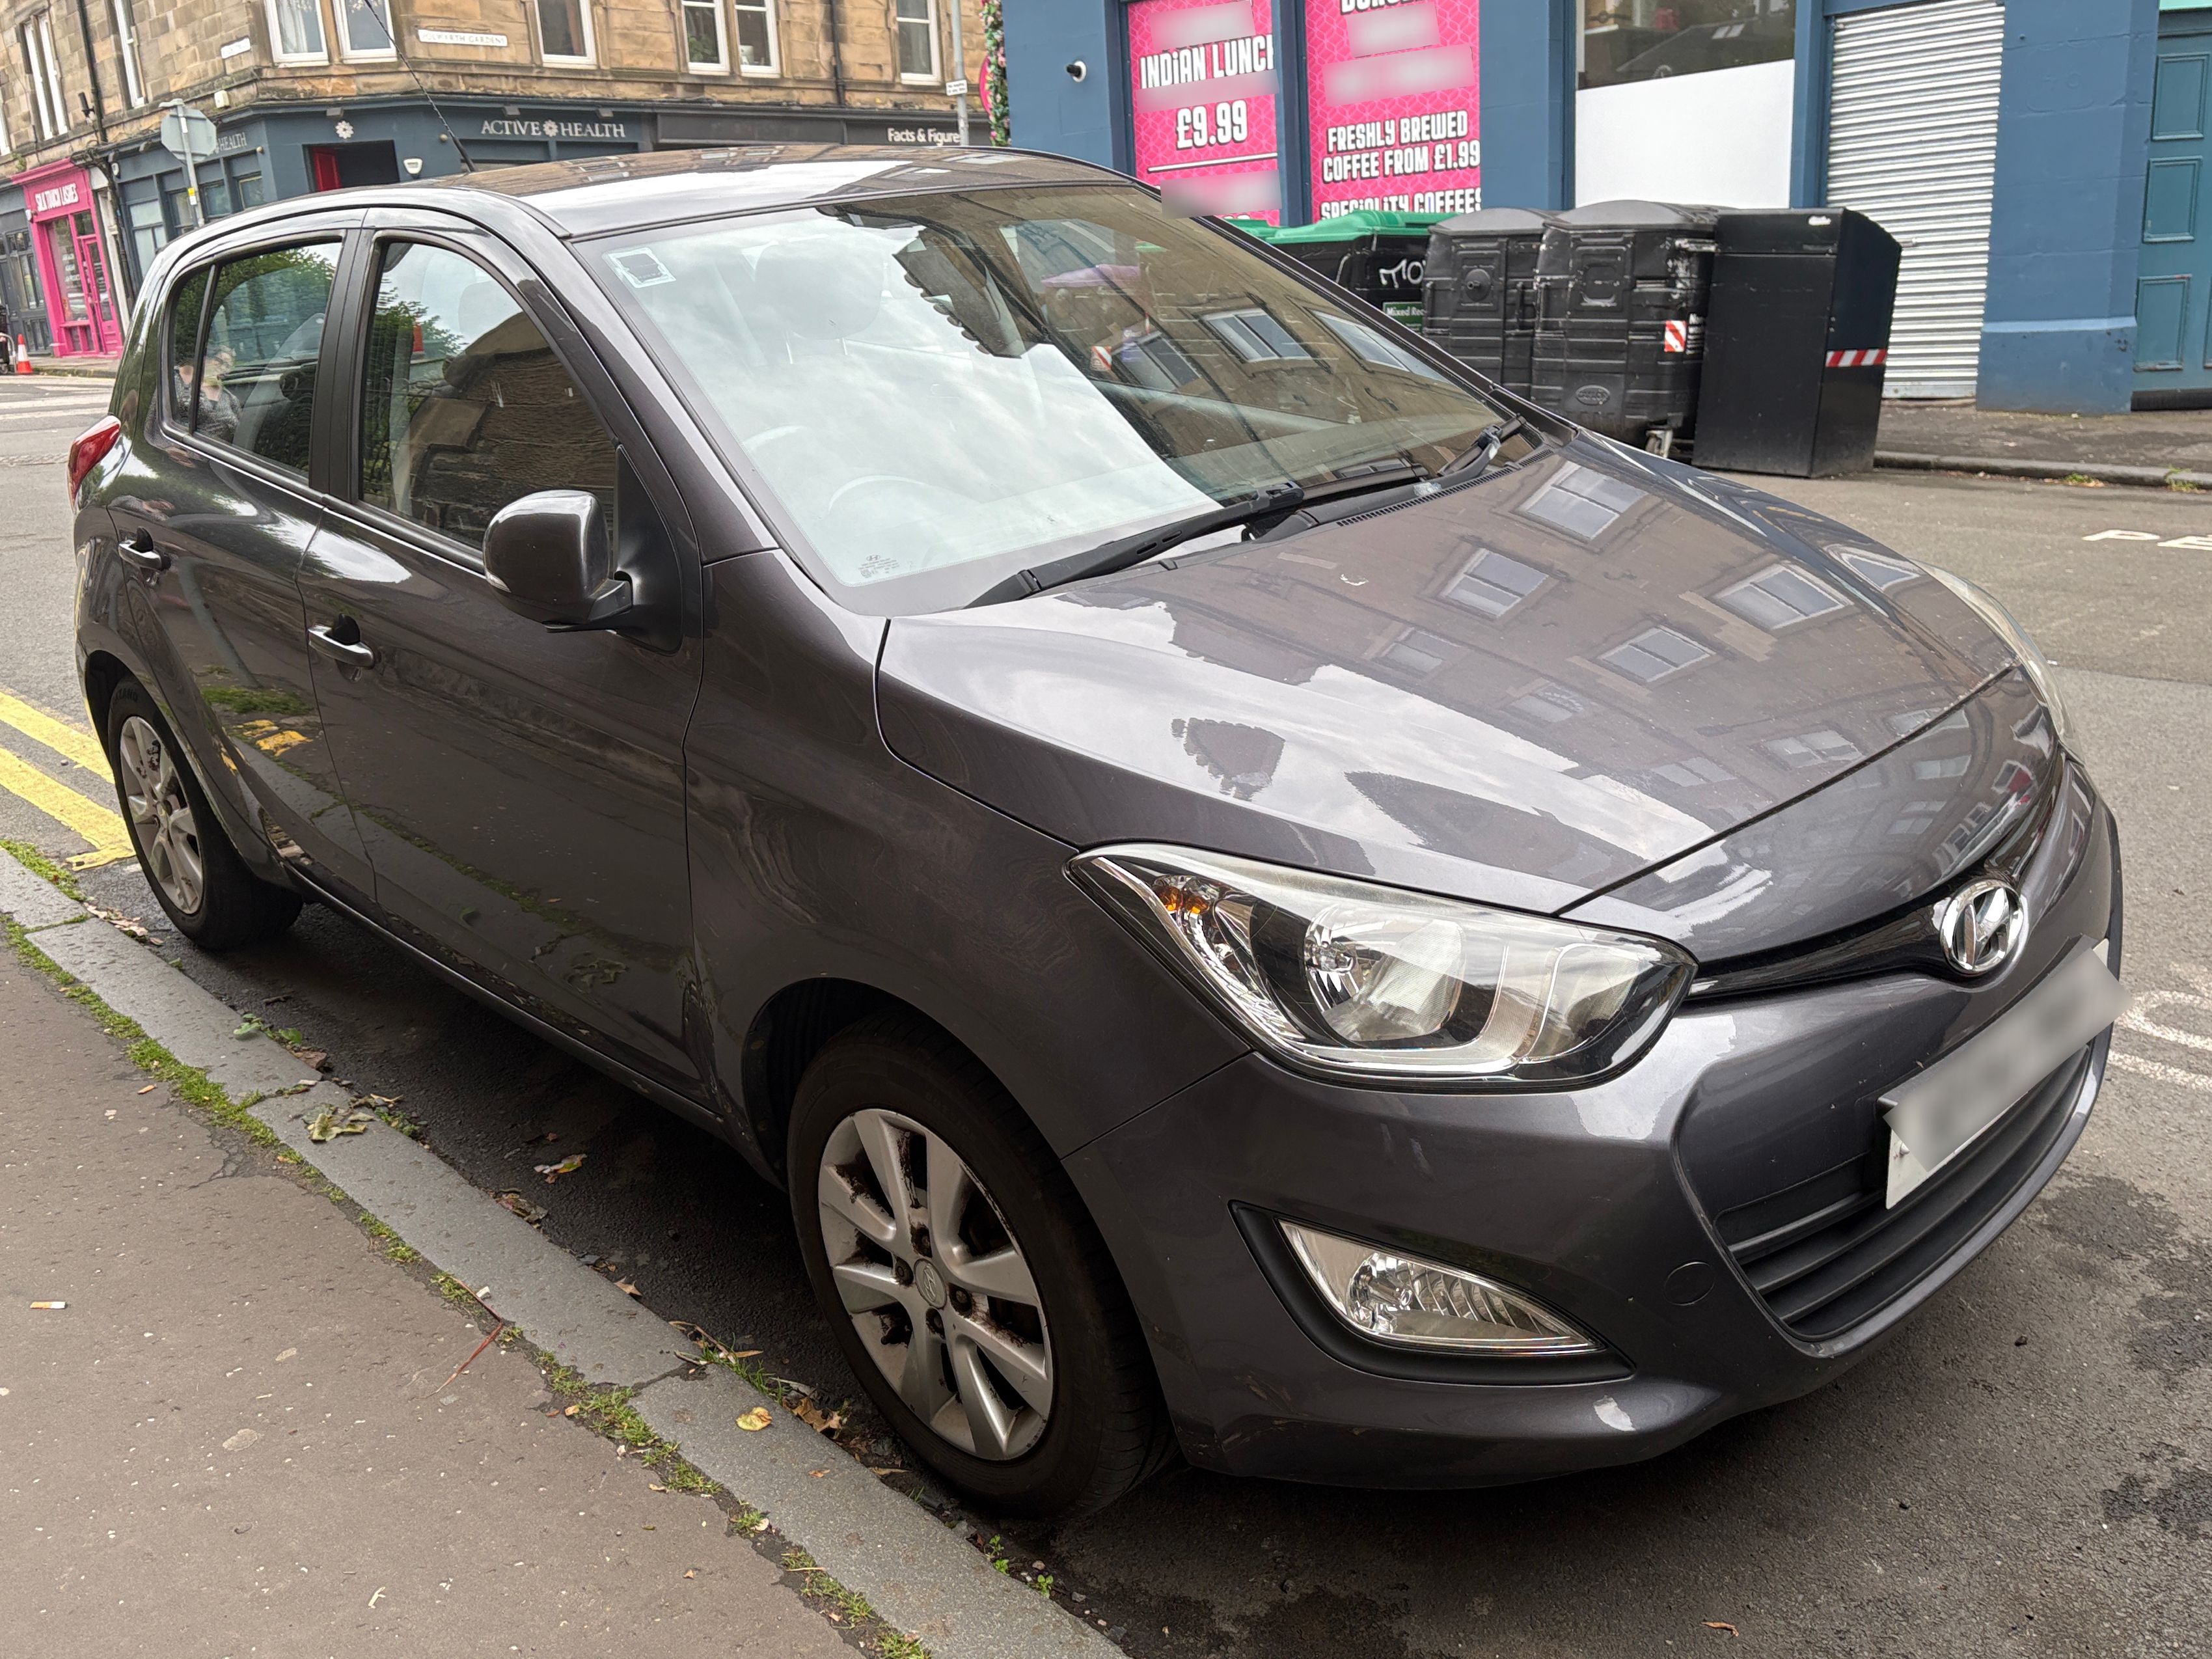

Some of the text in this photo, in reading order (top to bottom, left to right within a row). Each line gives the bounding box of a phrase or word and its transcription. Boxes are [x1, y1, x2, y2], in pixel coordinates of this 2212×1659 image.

[481, 120, 626, 138] ACTIVE HEALTH
[888, 128, 916, 143] Facts
[917, 128, 927, 143] &
[1176, 99, 1248, 149] £9.99
[1327, 110, 1468, 153] FRESHLY BREWED
[217, 131, 247, 152] HEALTH
[1322, 139, 1481, 183] COFFEE FROM £1.99
